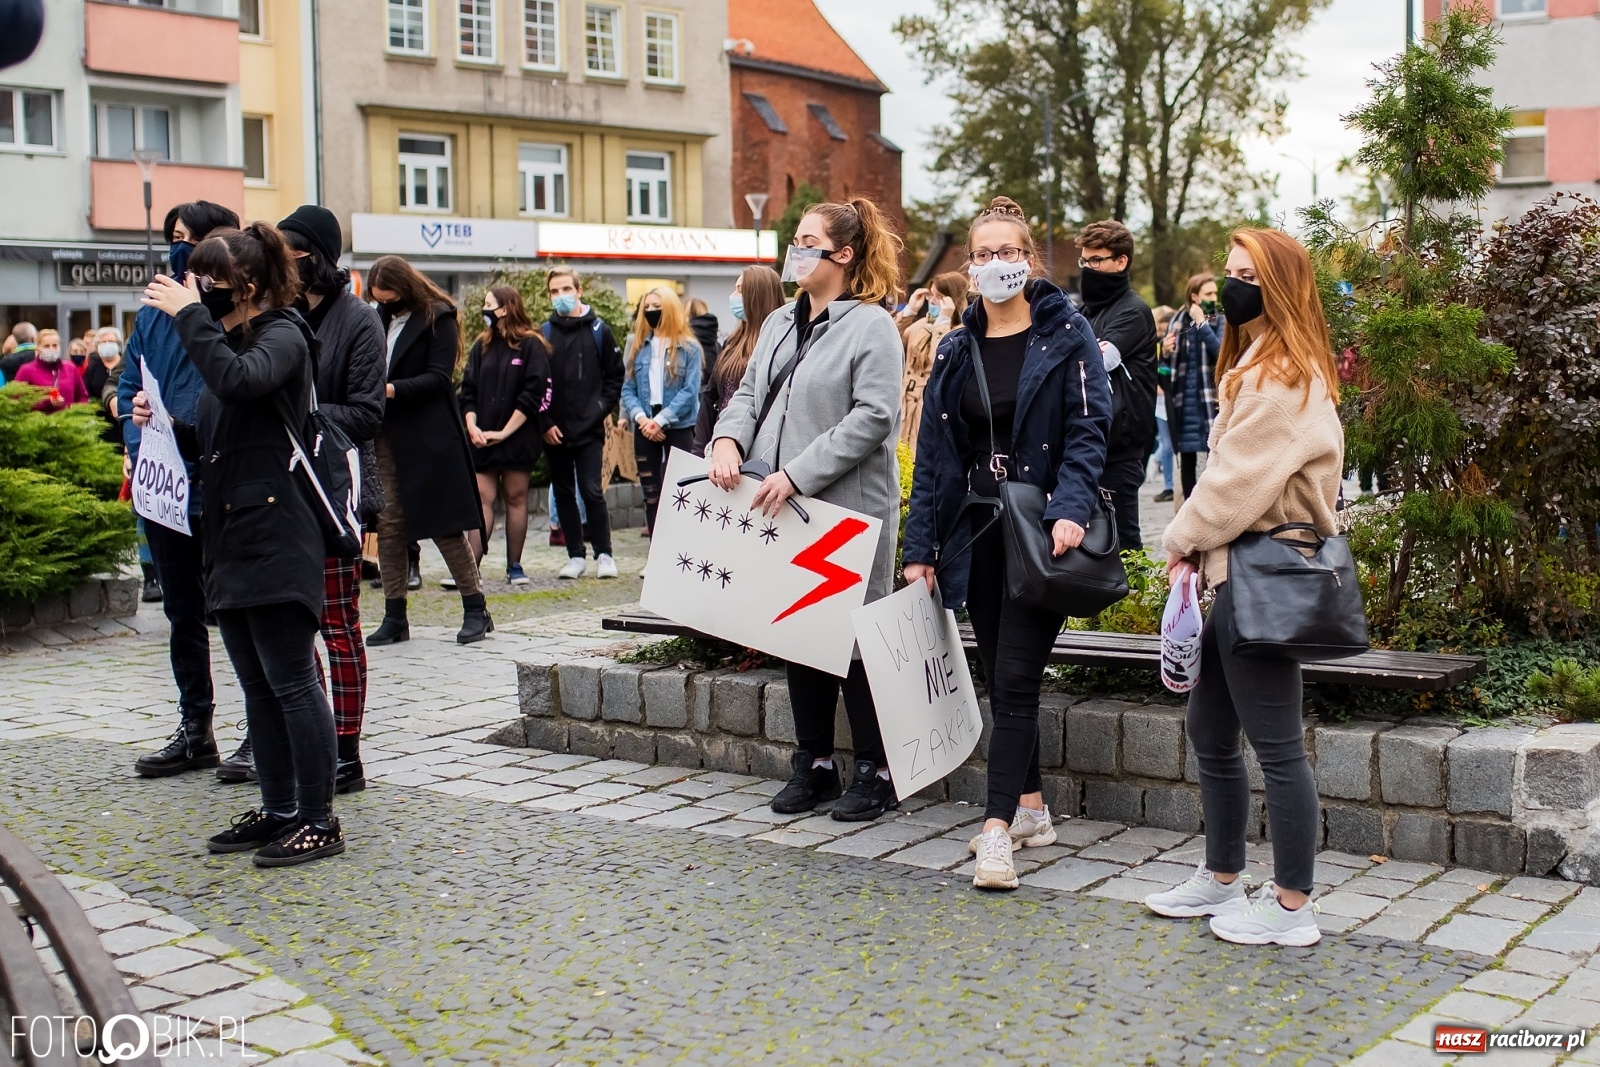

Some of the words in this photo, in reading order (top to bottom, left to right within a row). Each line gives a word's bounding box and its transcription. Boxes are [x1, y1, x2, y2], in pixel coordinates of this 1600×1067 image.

[445, 224, 472, 237] TEB
[608, 228, 717, 251] ROSSMANN
[136, 488, 152, 513] NIE
[924, 651, 958, 705] NIE
[901, 700, 975, 781] ZAKAZ
